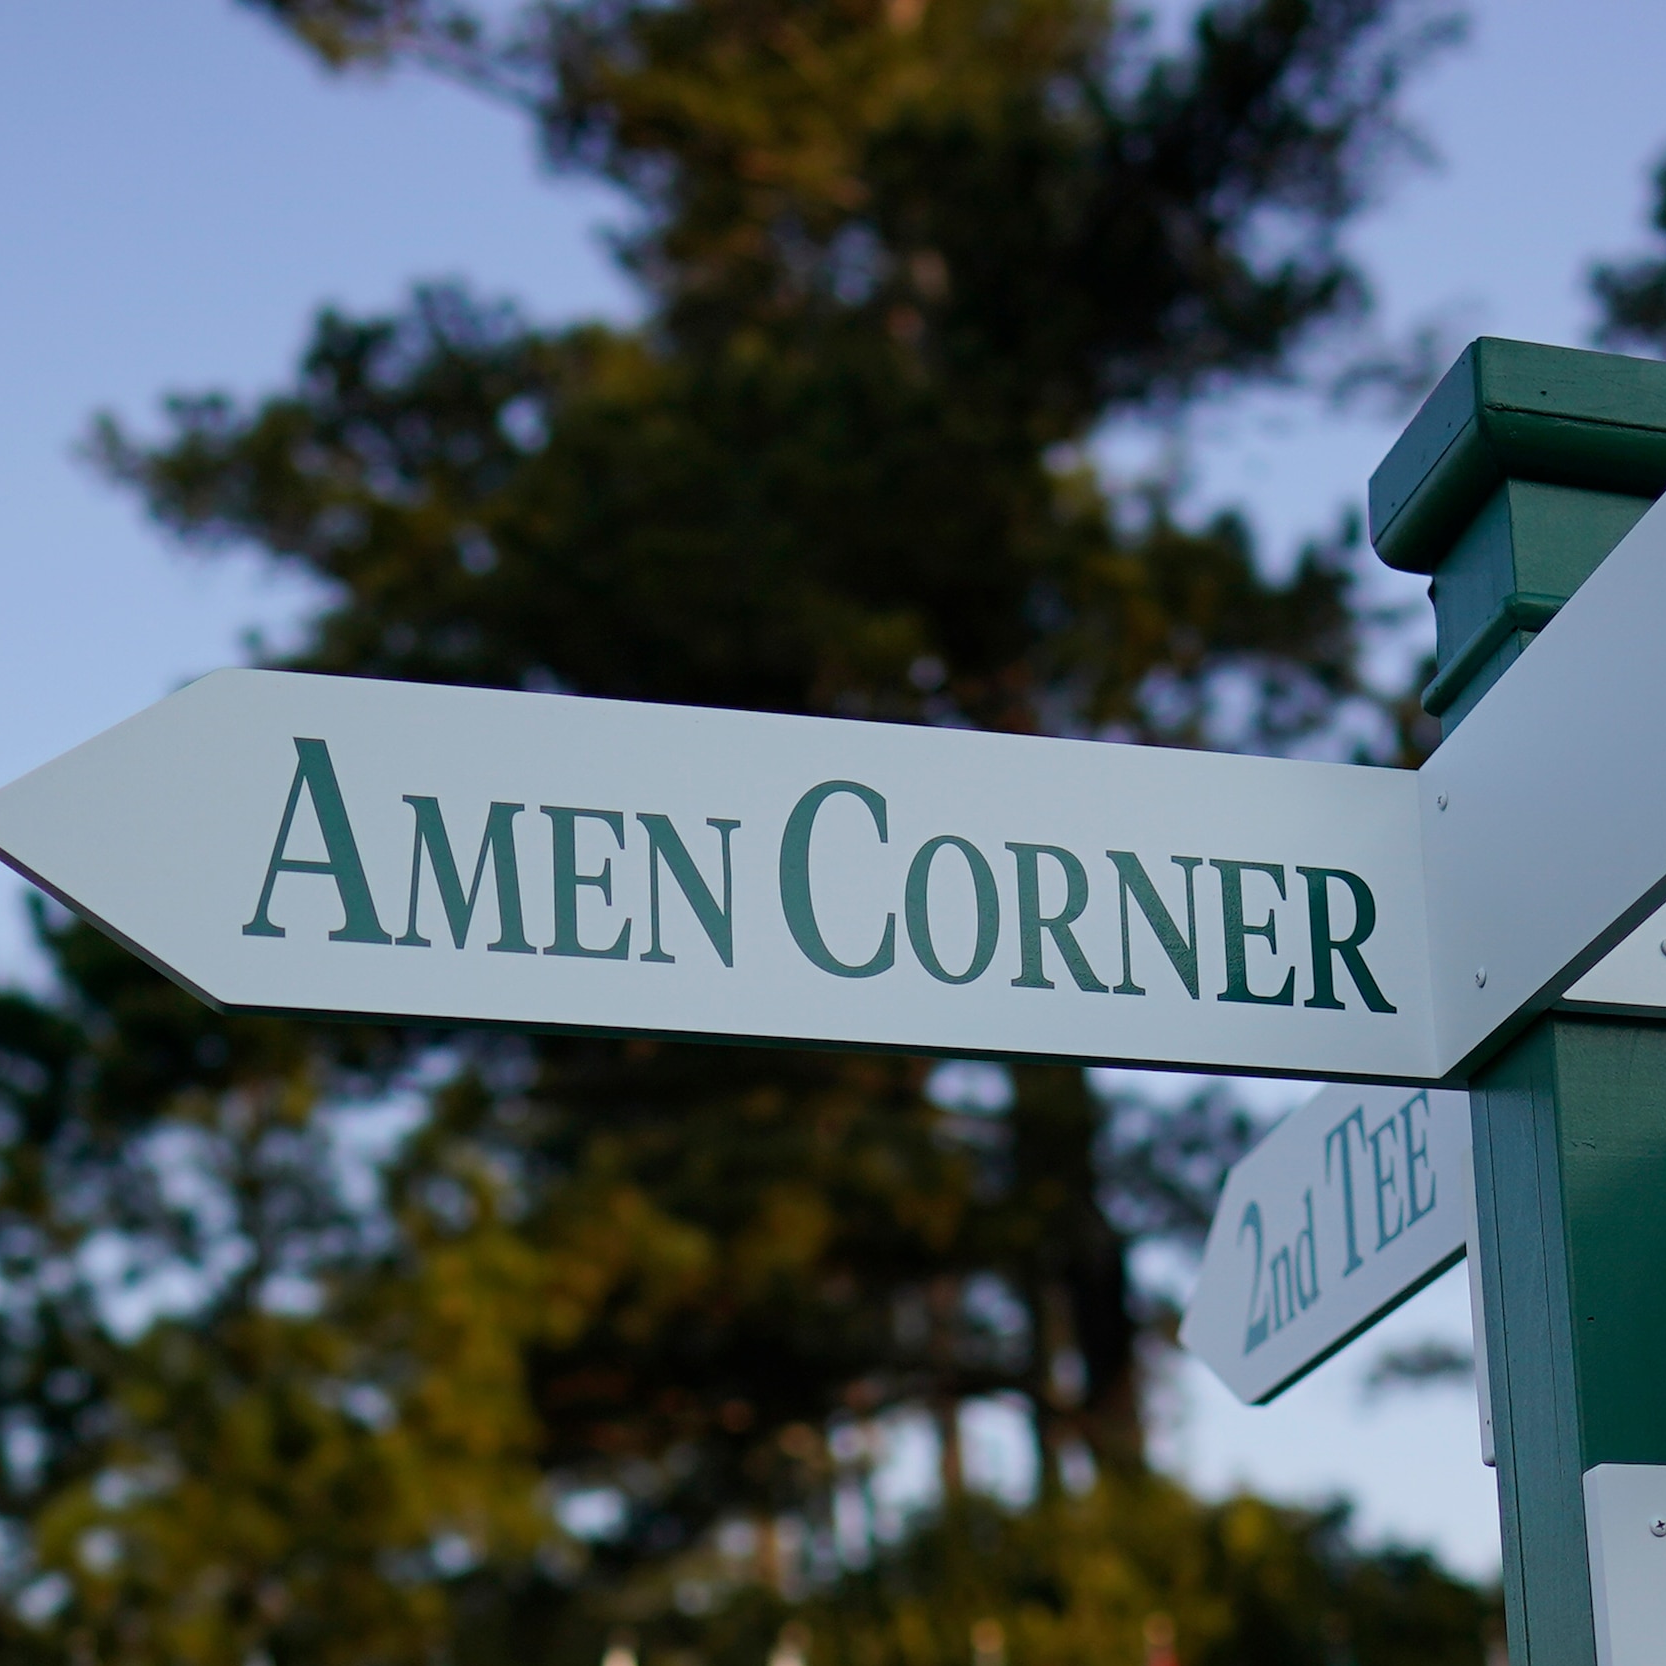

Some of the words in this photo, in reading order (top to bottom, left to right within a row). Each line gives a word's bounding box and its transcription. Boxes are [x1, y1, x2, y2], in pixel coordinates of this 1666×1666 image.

[241, 736, 741, 967] AMEN
[779, 779, 1398, 1015] CORNER
[1237, 1188, 1321, 1357] 2nd
[1323, 1089, 1437, 1279] TEE
